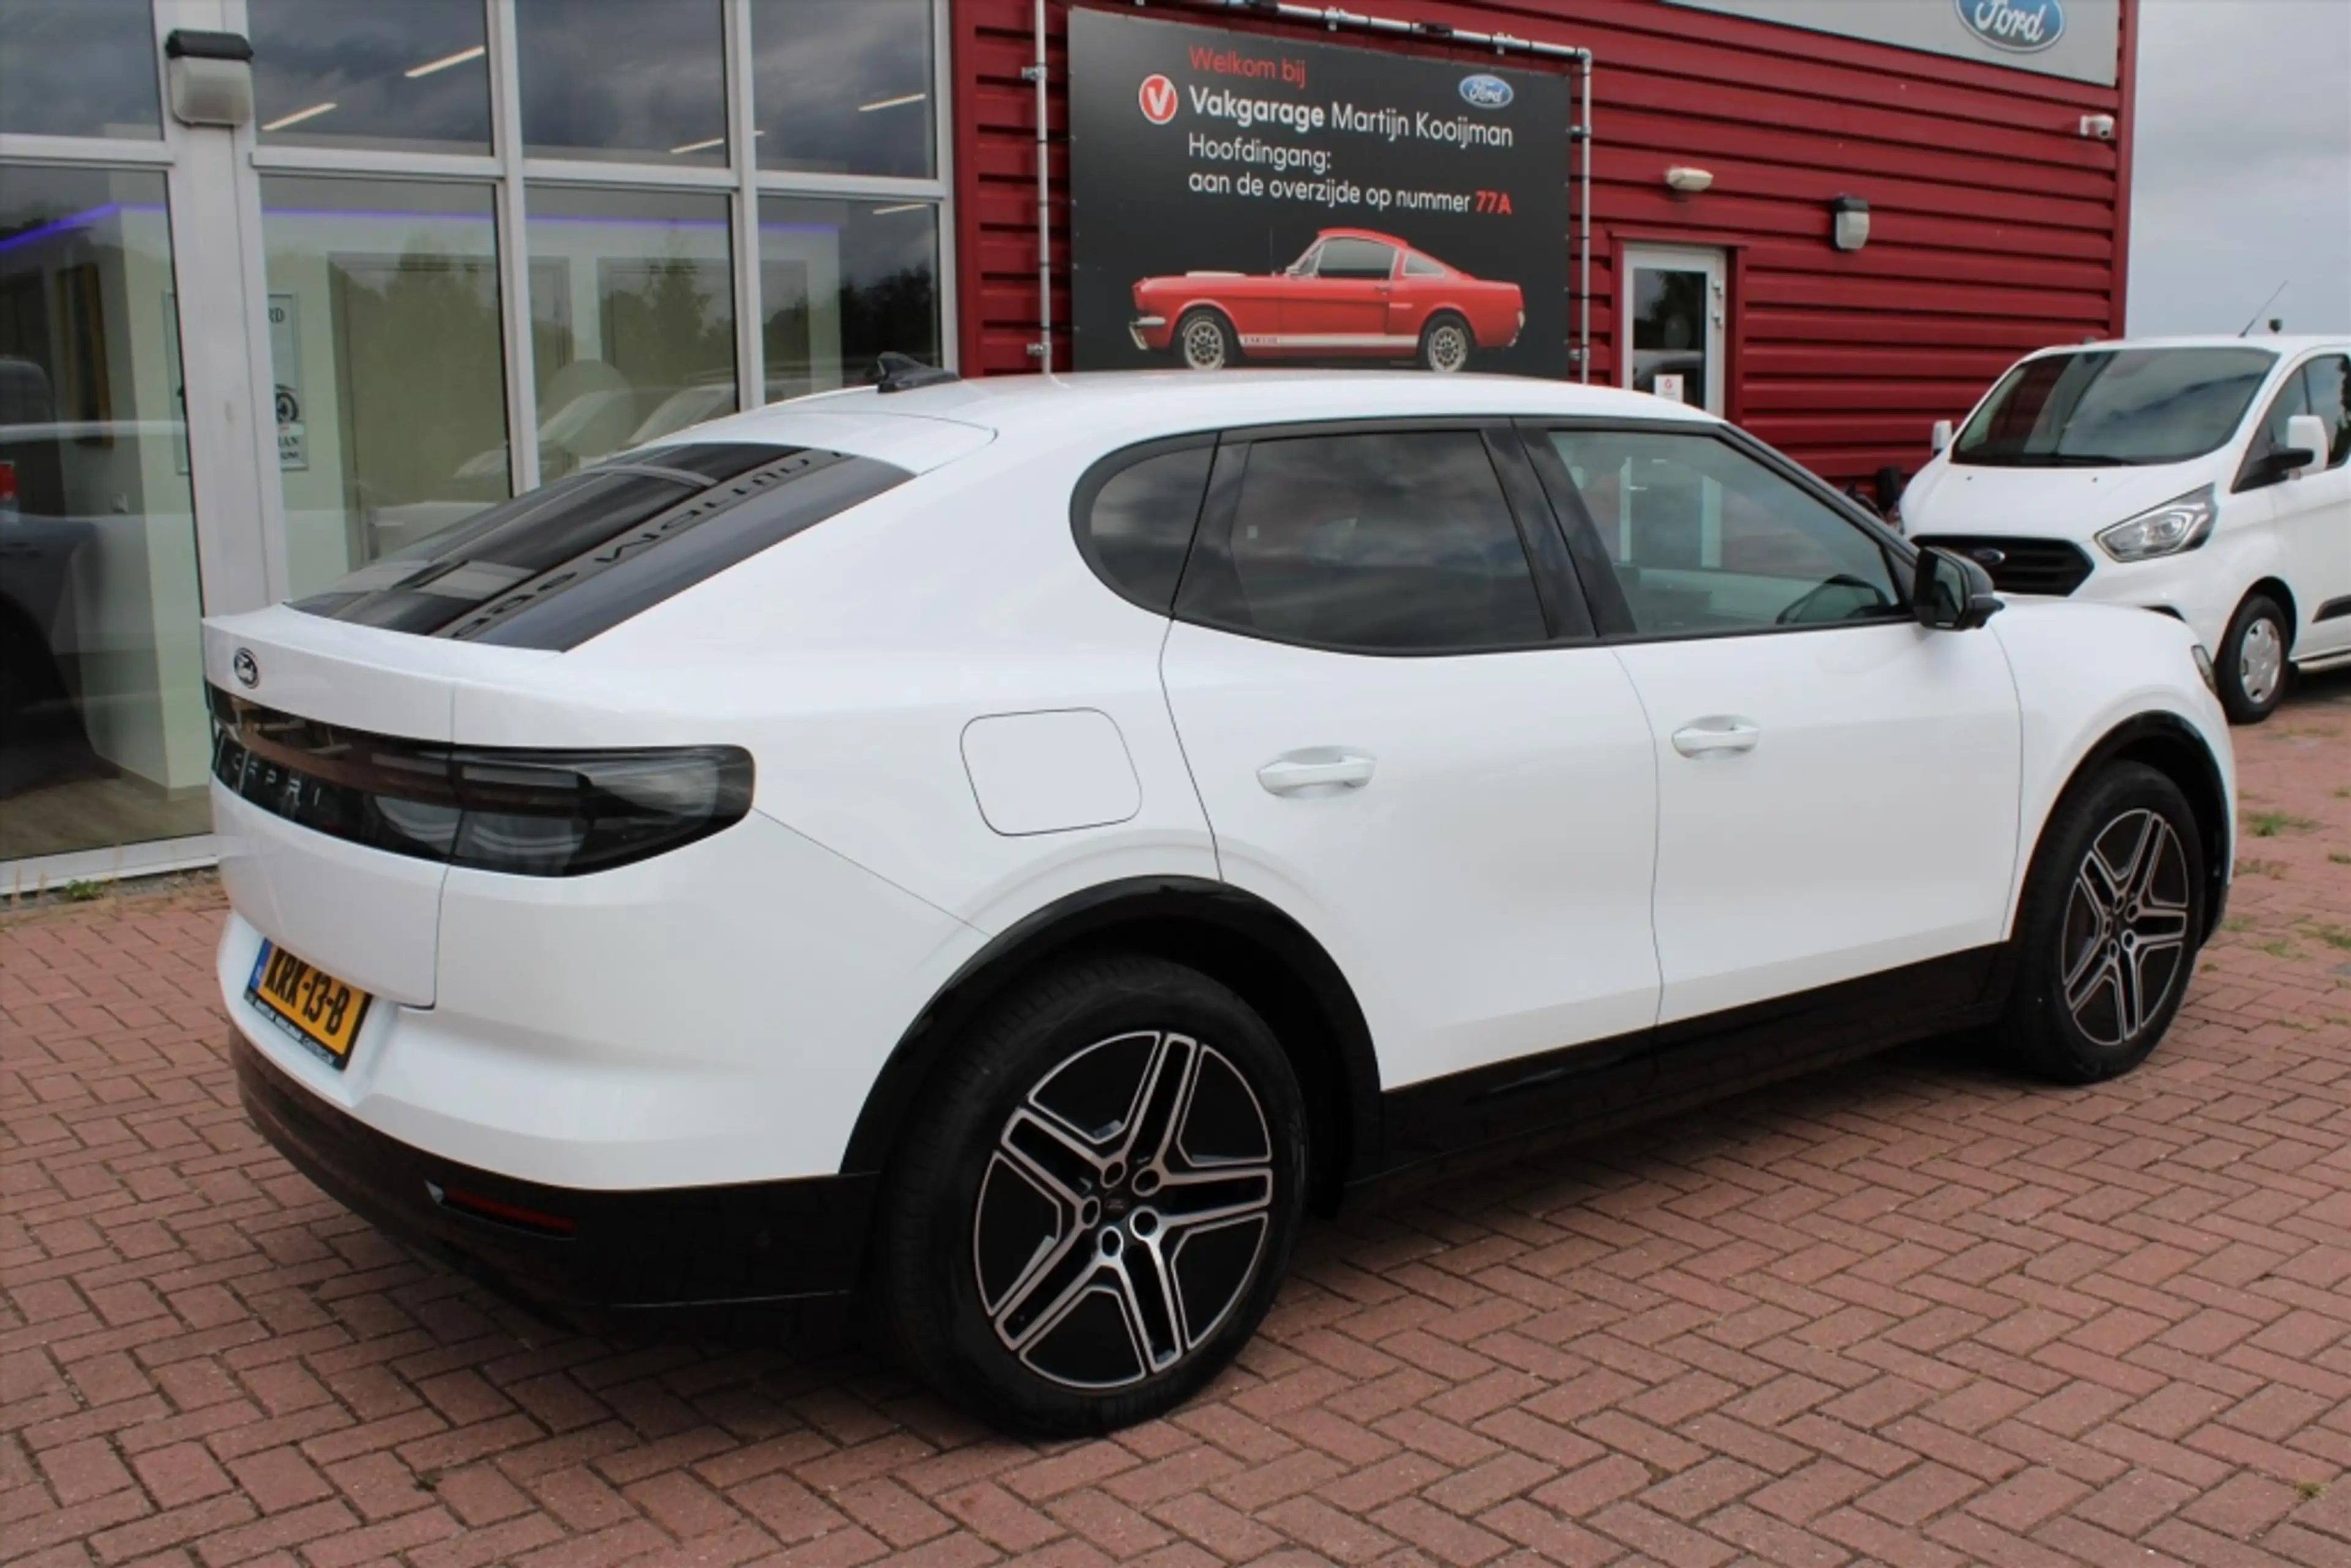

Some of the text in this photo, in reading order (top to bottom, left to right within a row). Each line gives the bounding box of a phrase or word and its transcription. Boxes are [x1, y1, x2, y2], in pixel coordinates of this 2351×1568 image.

[1974, 0, 2047, 43] Ford
[1188, 45, 1306, 89] Welkom bij
[1469, 79, 1504, 103] Ford
[1188, 84, 1513, 149] Vakgarage Martijn Kooijman
[1188, 132, 1332, 175] Hoofdingang:
[1188, 171, 1513, 215] aan de overzijde op nummer 77A
